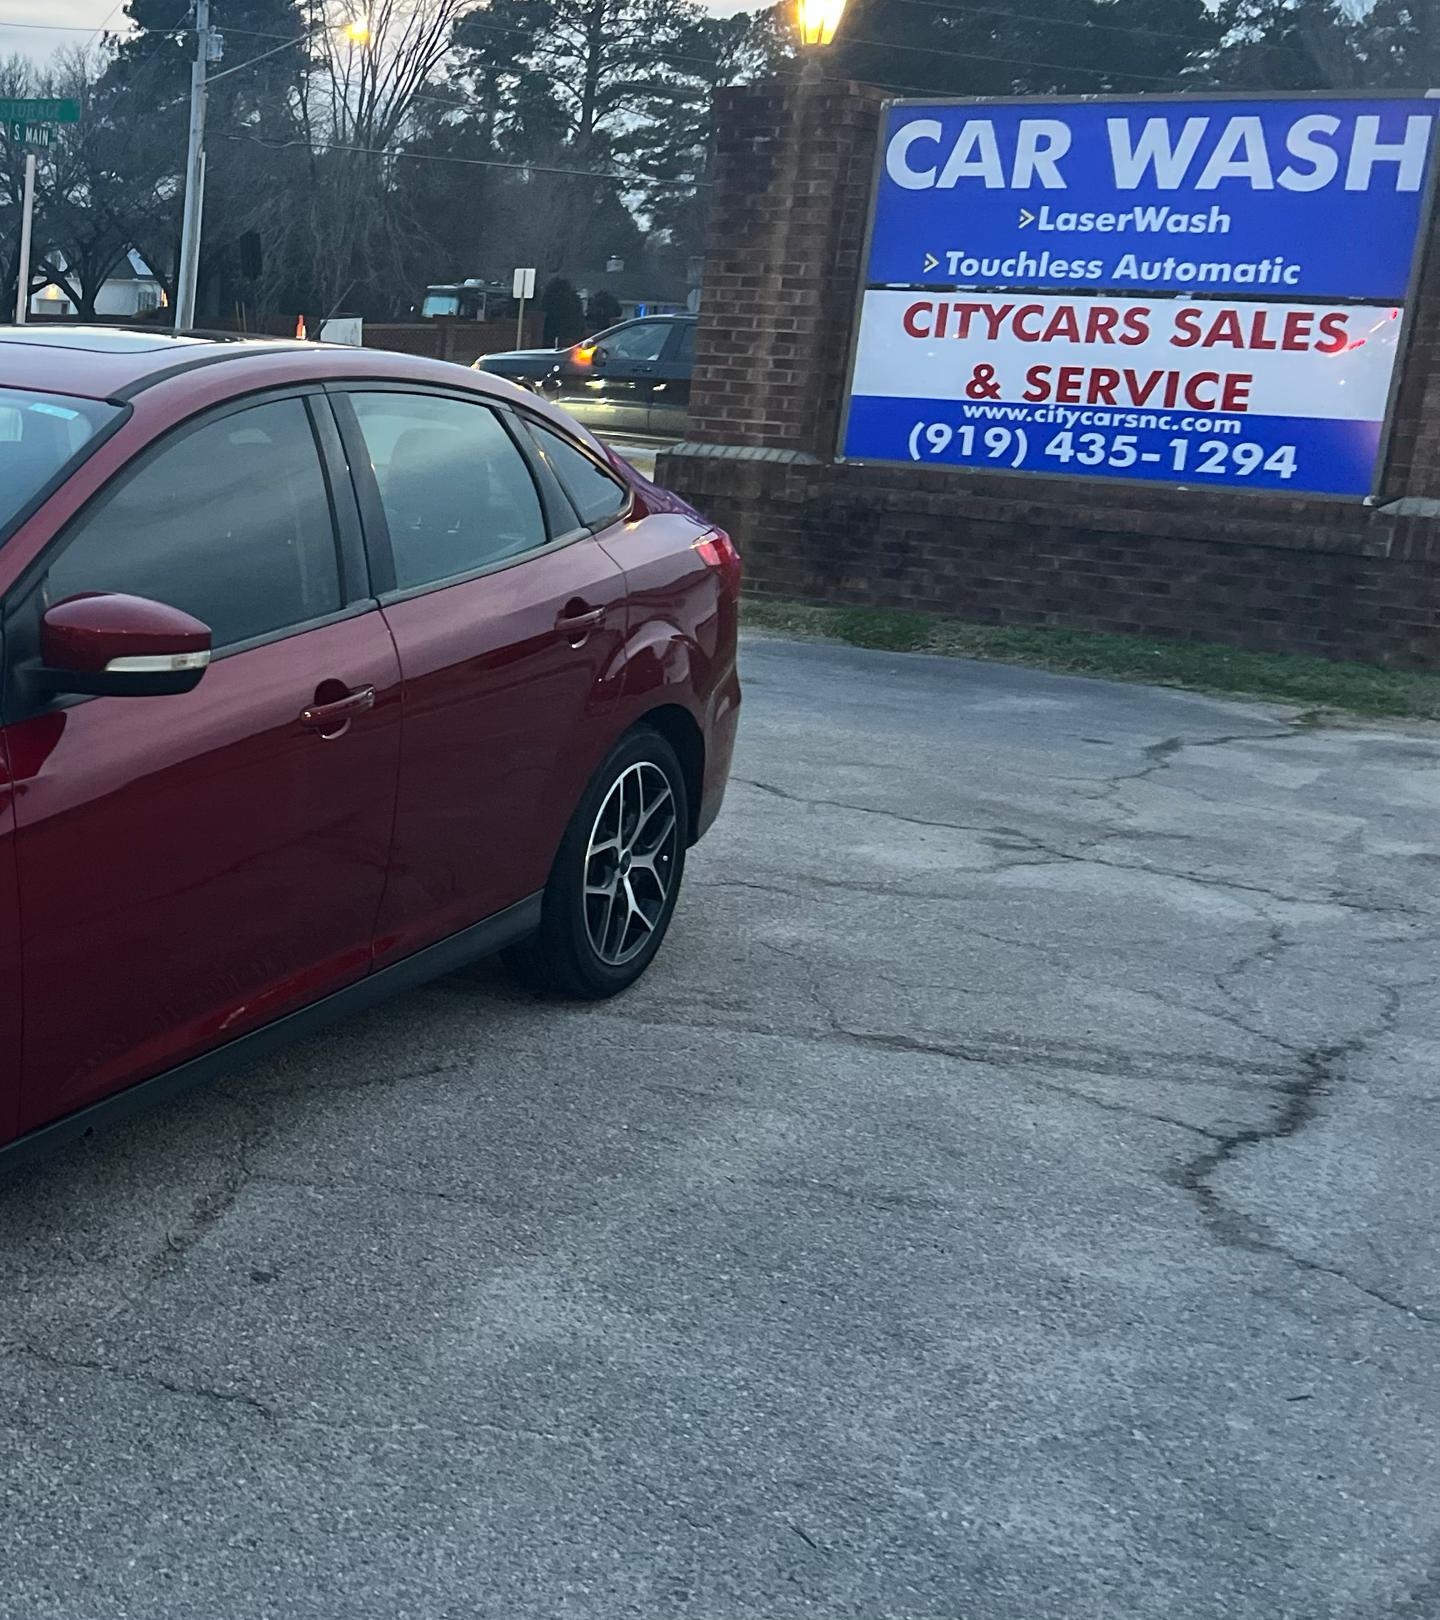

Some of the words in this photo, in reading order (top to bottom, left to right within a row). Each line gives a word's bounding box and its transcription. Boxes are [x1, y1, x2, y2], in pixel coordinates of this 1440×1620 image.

[25, 126, 49, 146] MAIN
[886, 118, 1072, 190] CAR
[1106, 115, 1432, 193] WASH
[1038, 206, 1231, 235] LaserWash
[945, 251, 1103, 280] Touchless
[1112, 255, 1301, 285] Automatic
[903, 301, 1151, 346] CITYCARS
[1169, 307, 1350, 353] SALES
[965, 363, 1001, 400] &
[1021, 365, 1252, 412] SERVICE
[963, 404, 1241, 435] www.citycarsnc.com
[908, 421, 1029, 468] (919)
[1045, 434, 1298, 479] 435-1294
